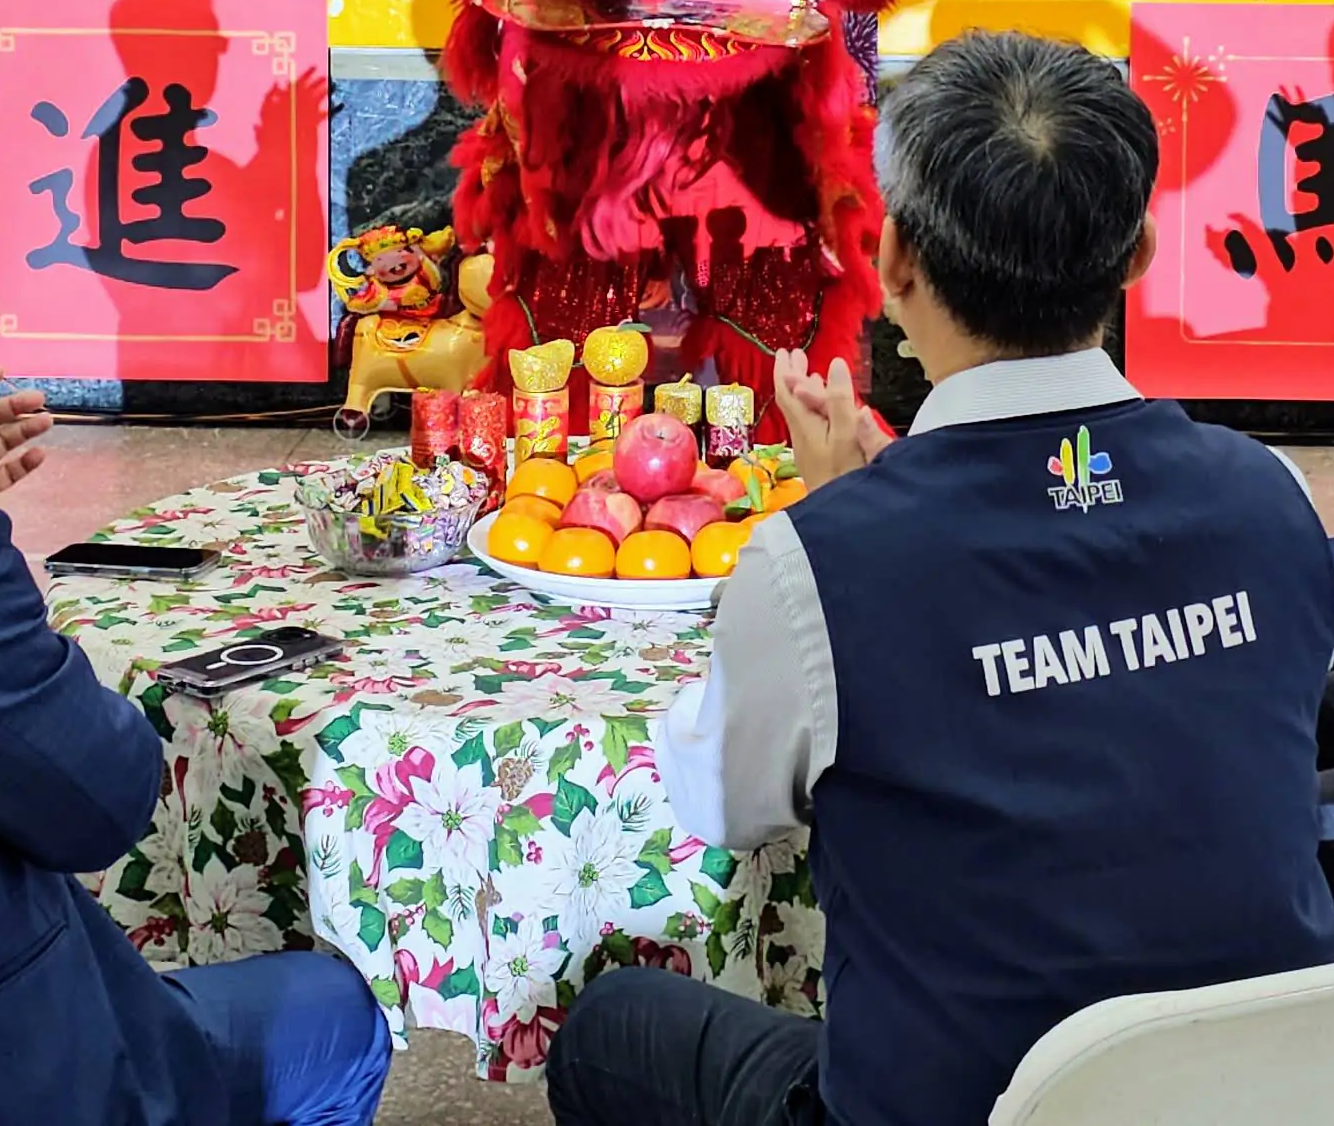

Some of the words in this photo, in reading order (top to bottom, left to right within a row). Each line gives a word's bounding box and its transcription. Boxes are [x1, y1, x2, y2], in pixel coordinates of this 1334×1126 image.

[26, 76, 240, 290] 進
[1048, 479, 1124, 512] TAIPEI
[971, 624, 1111, 697] TEAM
[1109, 590, 1257, 671] TAIPEI
